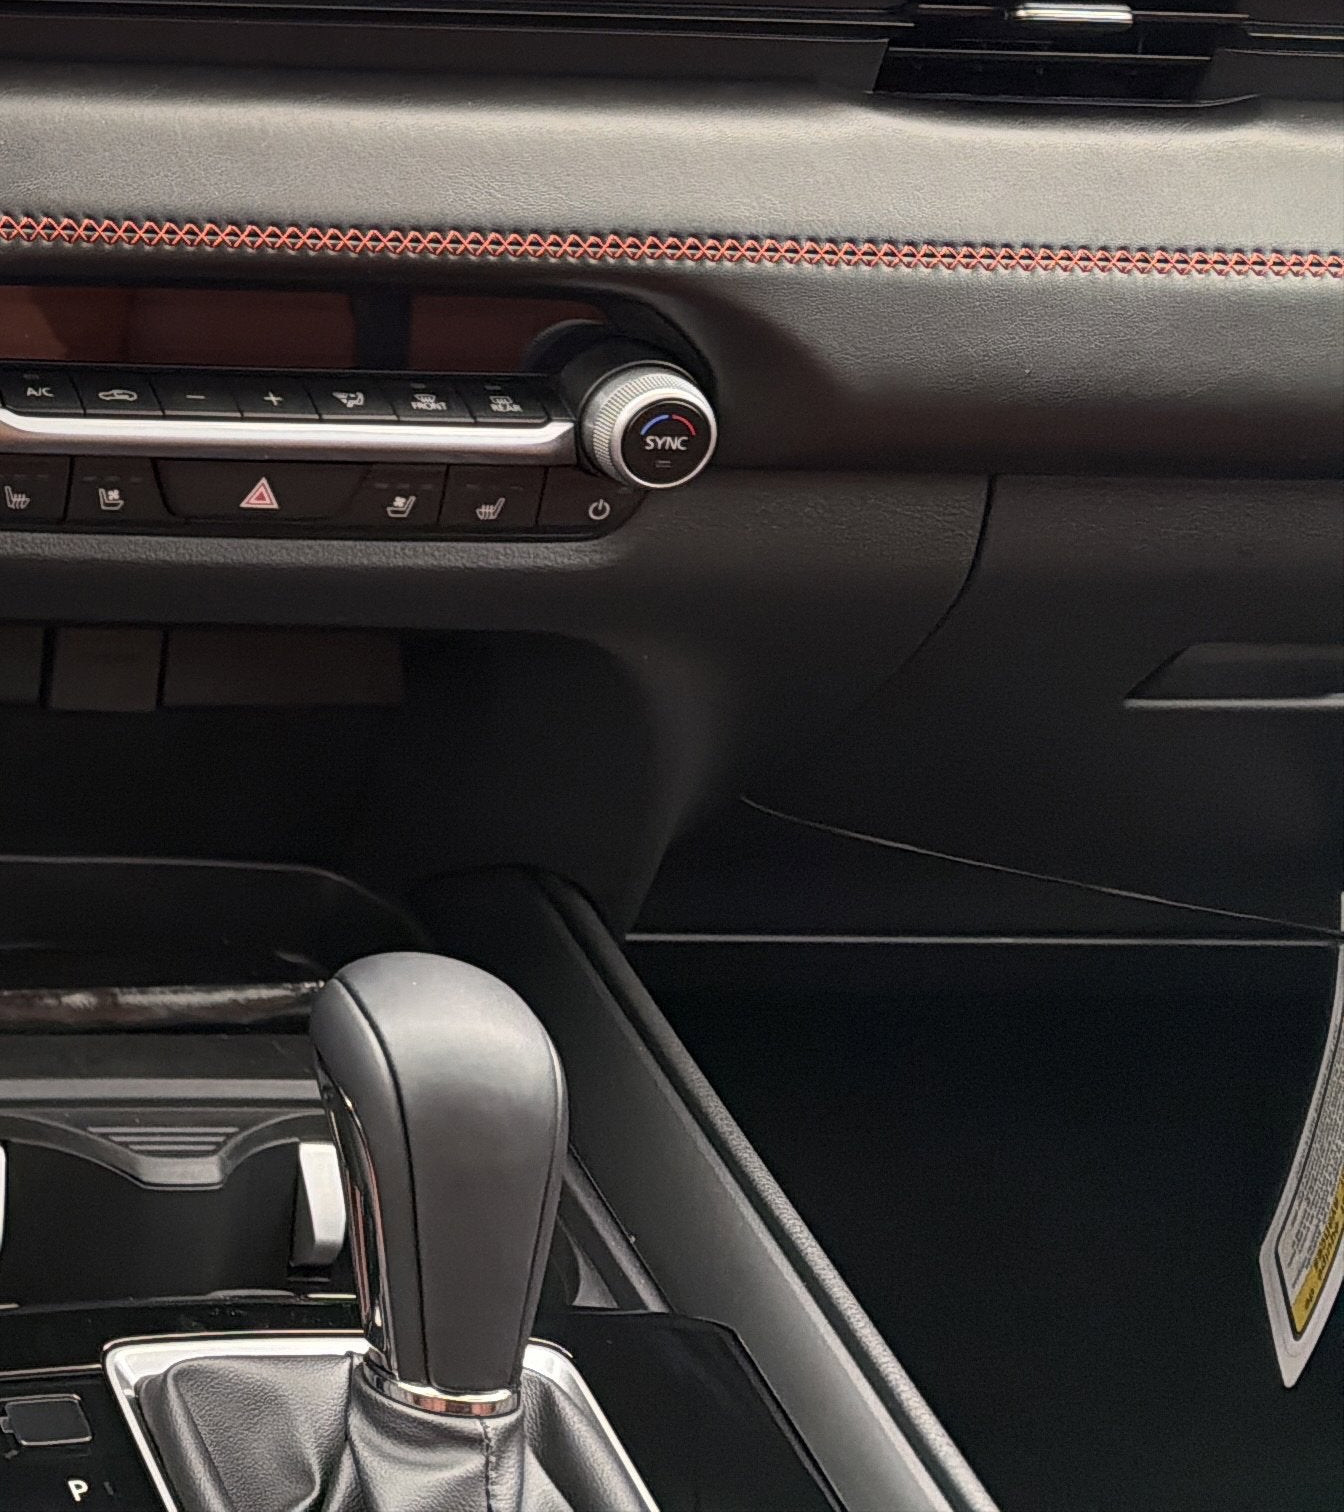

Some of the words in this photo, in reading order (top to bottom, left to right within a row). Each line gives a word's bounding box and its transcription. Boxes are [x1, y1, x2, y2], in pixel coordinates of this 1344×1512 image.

[27, 386, 54, 397] A/C
[411, 400, 447, 412] FRONT
[492, 403, 522, 412] REAR
[645, 437, 687, 451] SYNC
[68, 1479, 88, 1502] P
